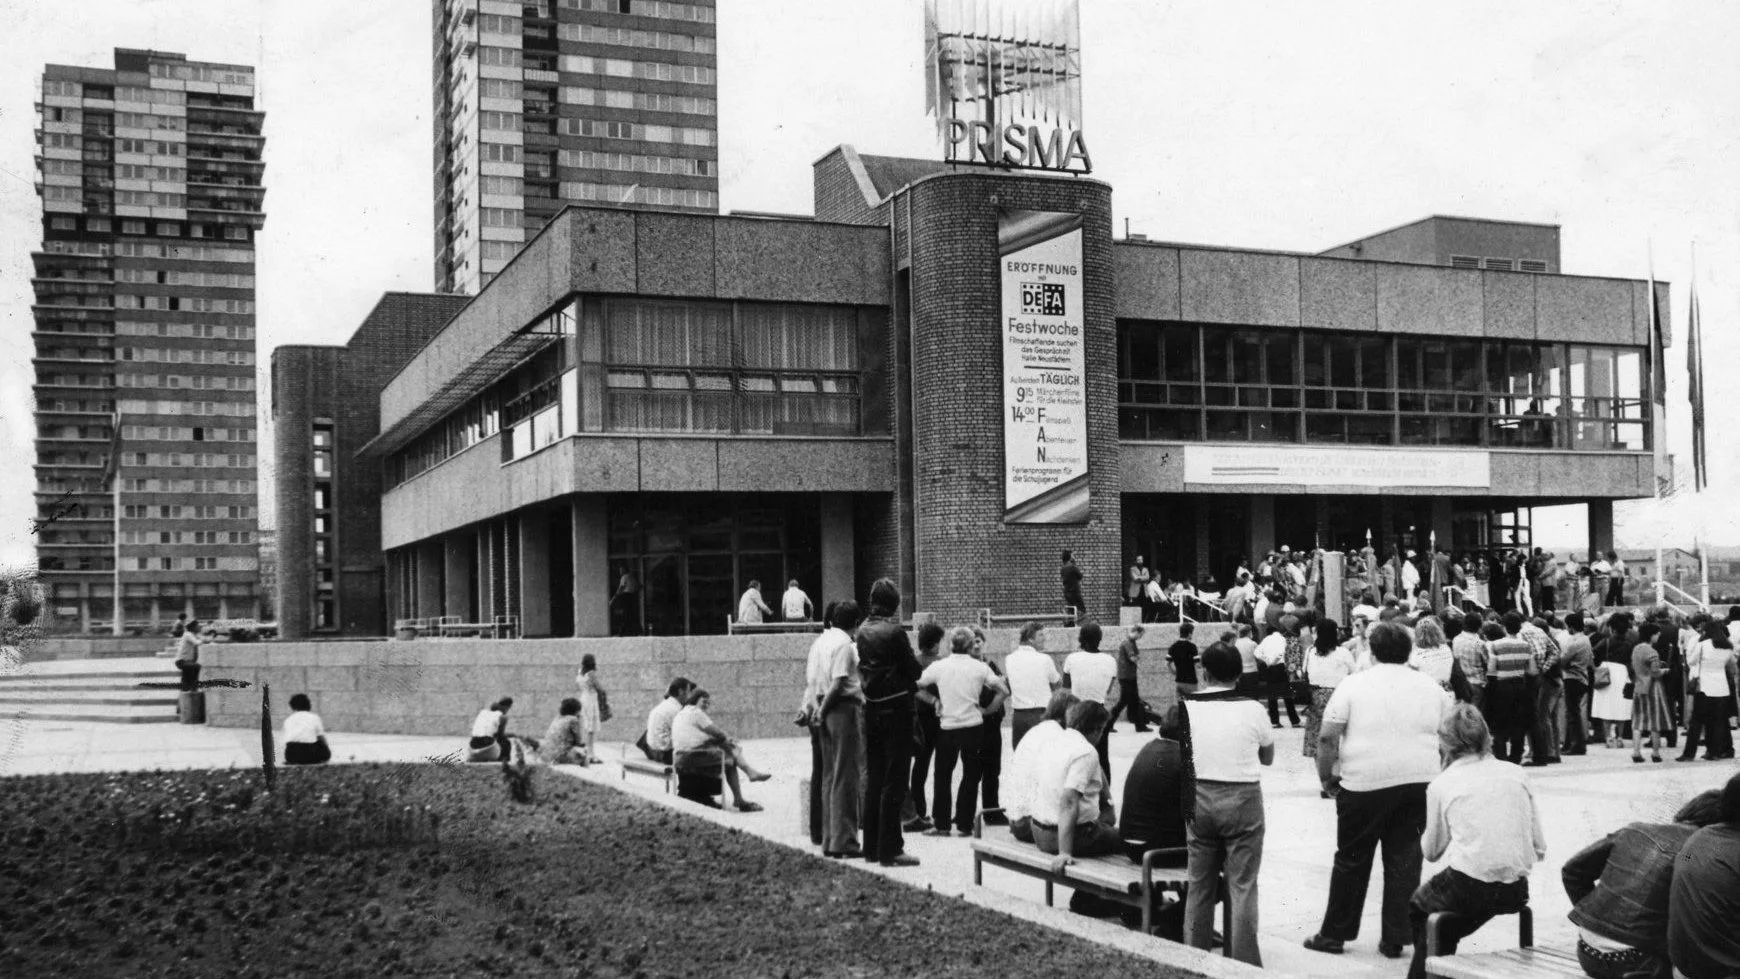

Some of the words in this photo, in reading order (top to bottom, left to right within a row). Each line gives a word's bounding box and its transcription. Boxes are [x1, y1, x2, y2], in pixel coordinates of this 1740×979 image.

[944, 119, 1092, 170] PRISMA
[1007, 261, 1077, 275] ERÖFFNUNG
[1023, 291, 1062, 307] DEFA
[1009, 317, 1079, 335] Festwoche
[1056, 339, 1077, 347] suchen
[1040, 372, 1080, 385] TÄGLICH
